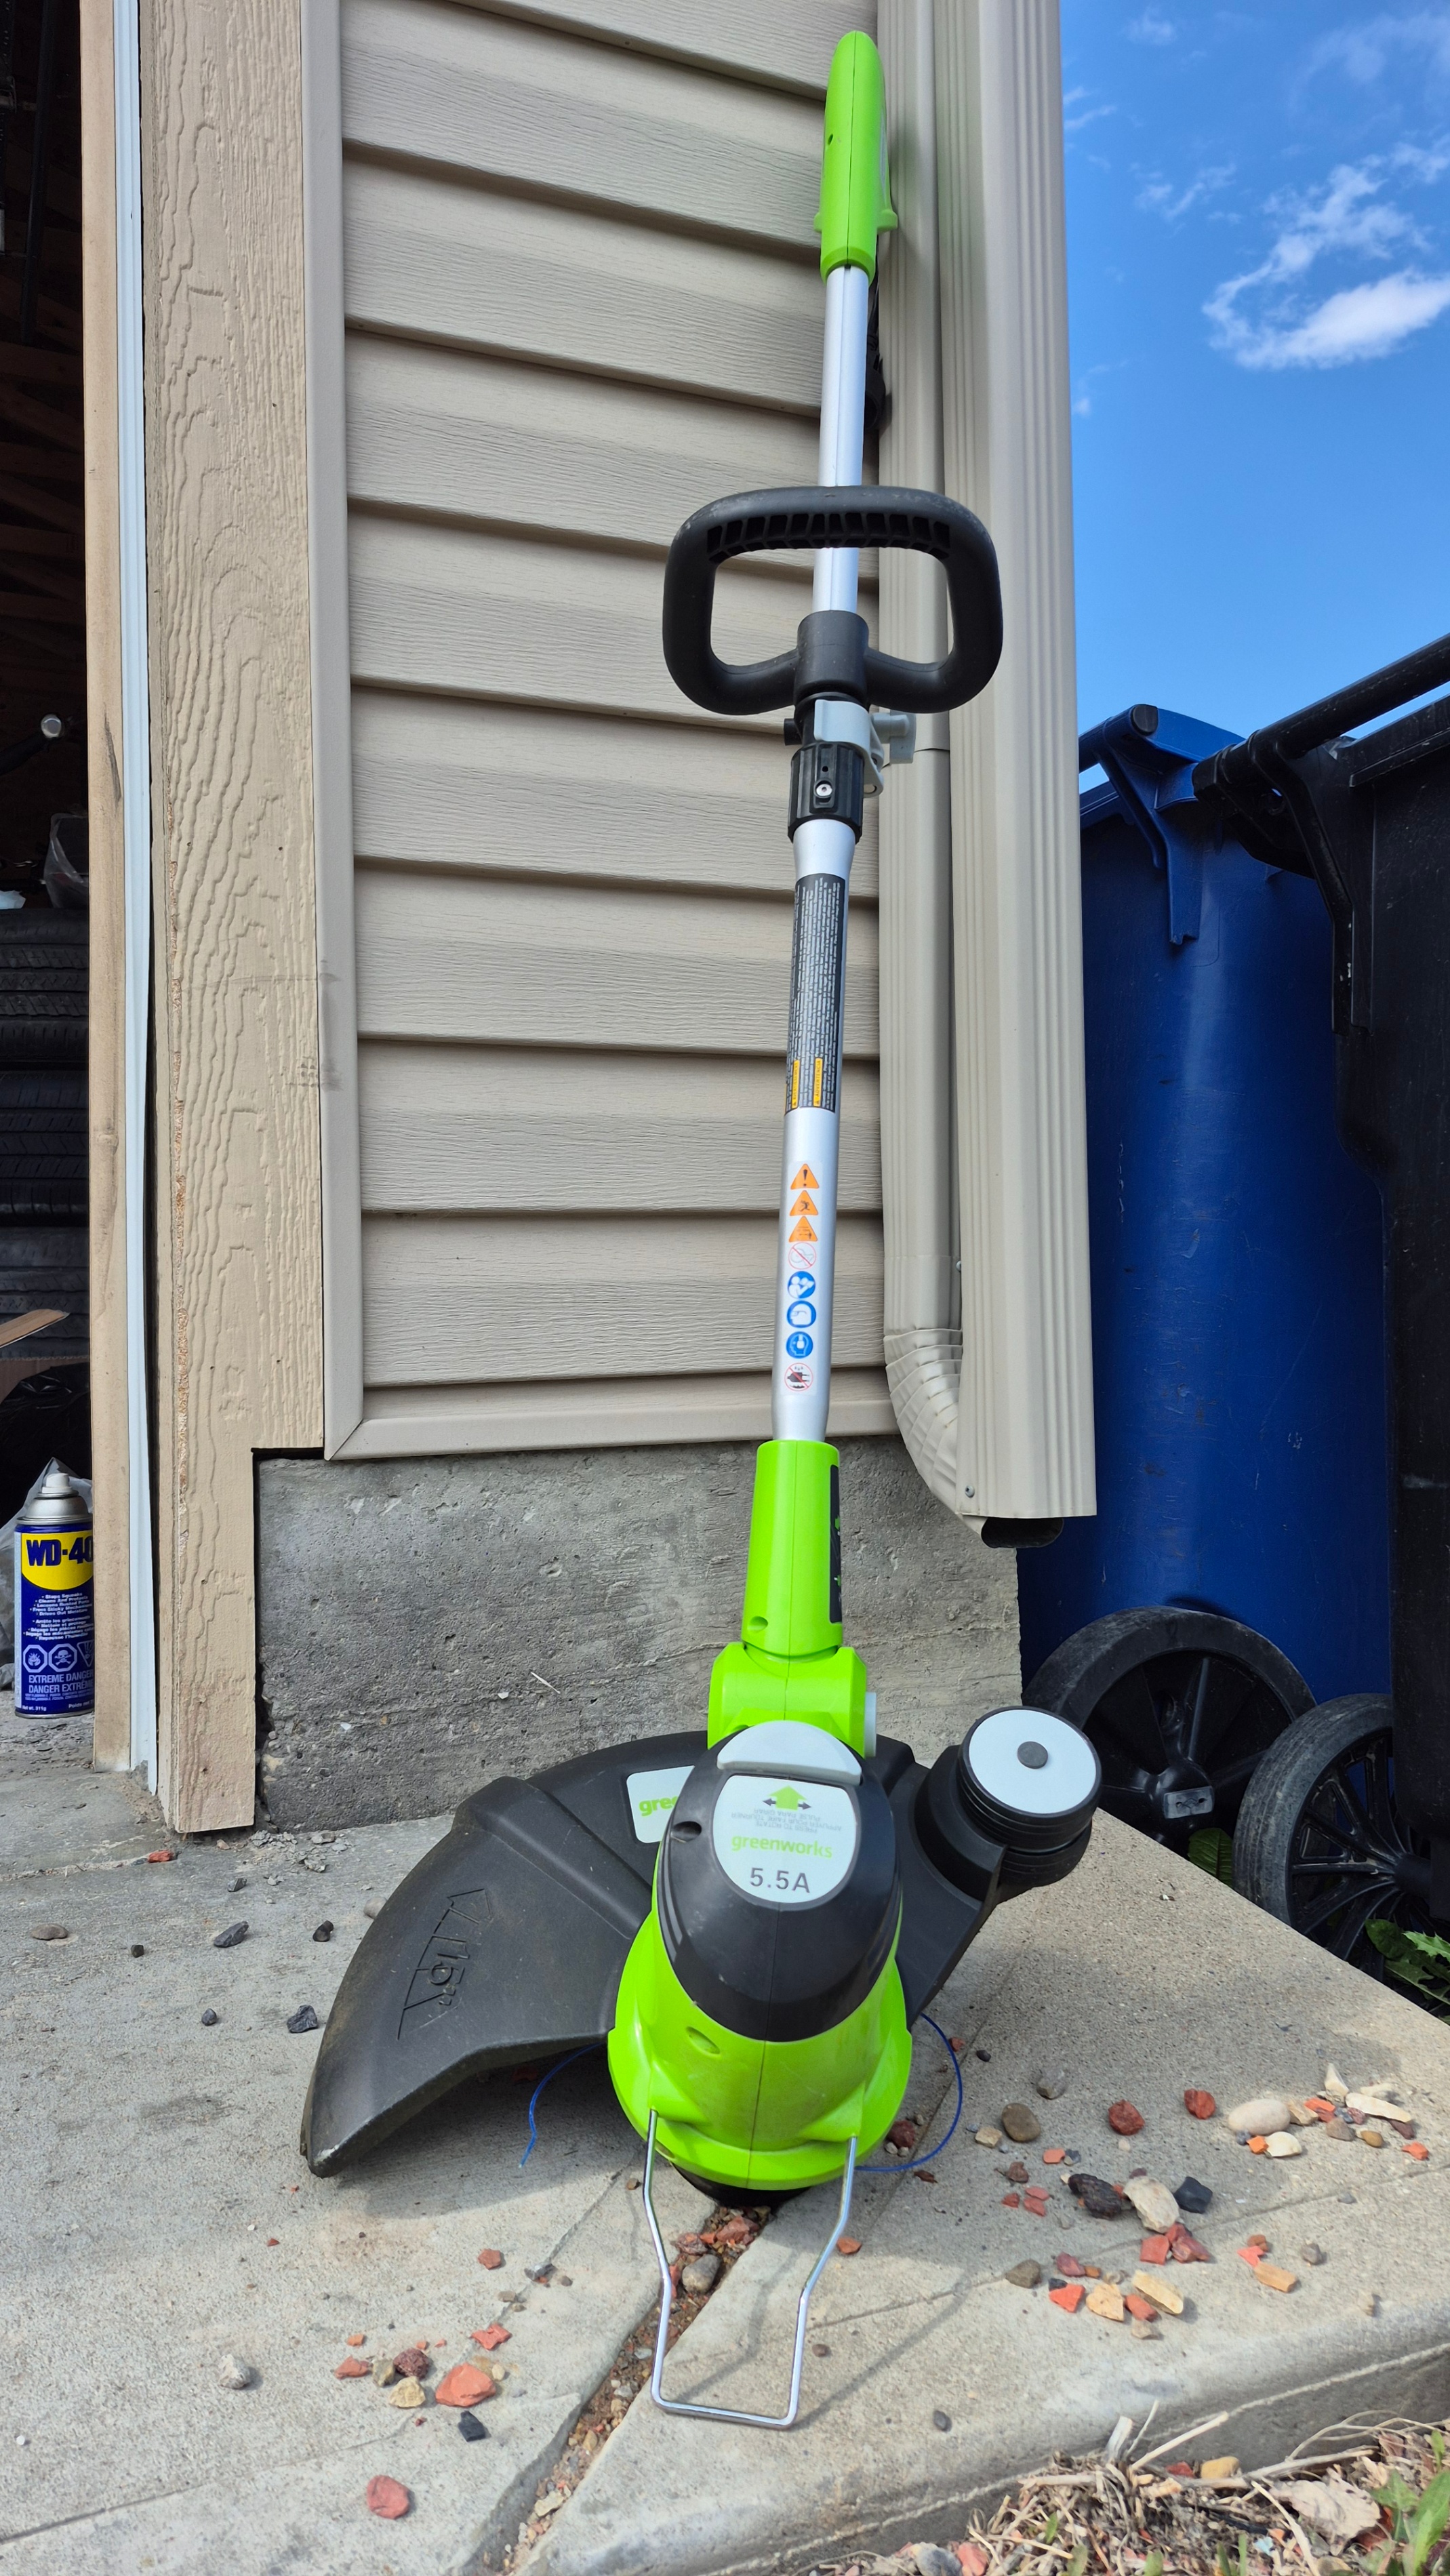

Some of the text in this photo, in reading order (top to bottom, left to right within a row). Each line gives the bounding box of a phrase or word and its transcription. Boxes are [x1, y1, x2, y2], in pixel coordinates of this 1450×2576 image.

[26, 1535, 94, 1566] WD-40
[28, 1669, 93, 1683] EXTREME DANGER
[28, 1685, 60, 1693] DANGER
[755, 1820, 782, 1829] ROTATE
[731, 1834, 833, 1859] greenworks
[750, 1867, 811, 1893] 5.5A
